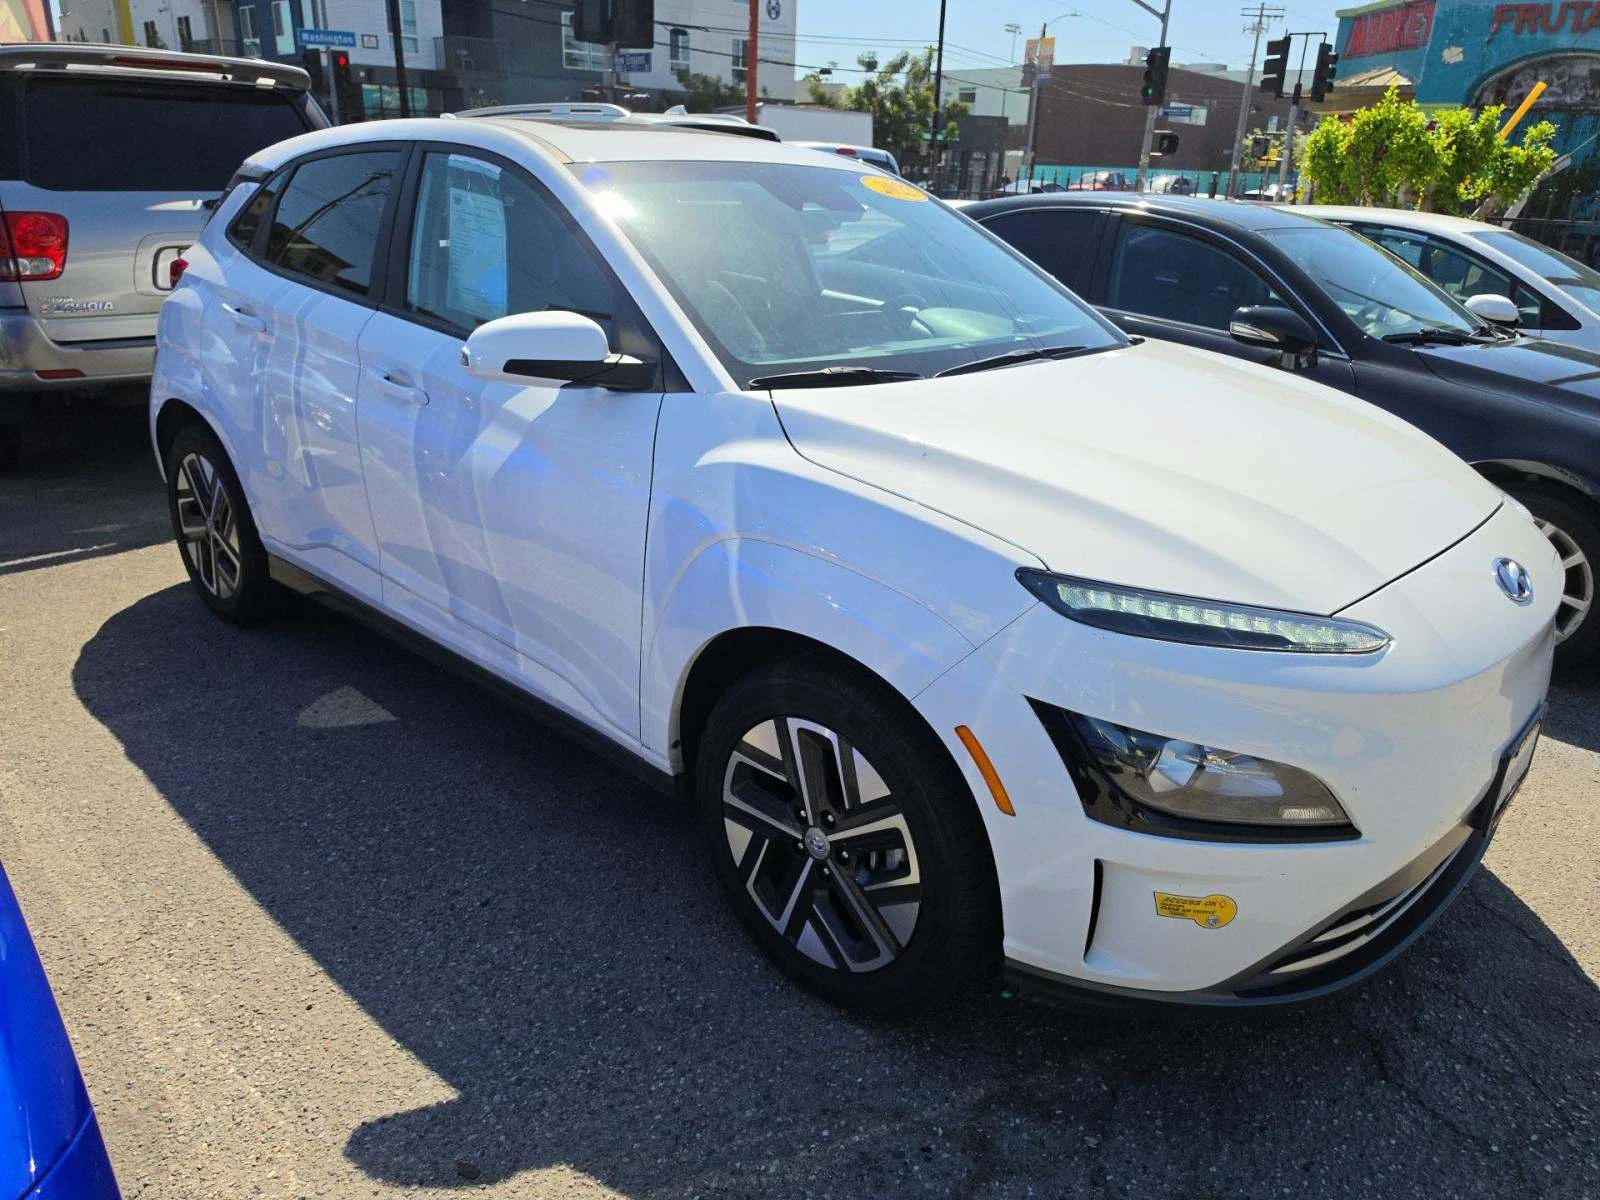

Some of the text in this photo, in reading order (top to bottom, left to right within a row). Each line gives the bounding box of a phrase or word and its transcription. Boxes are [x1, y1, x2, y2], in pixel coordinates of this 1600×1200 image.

[301, 31, 354, 45] Washington
[40, 301, 114, 314] SEQUOIA
[1163, 896, 1201, 906] ACCESS
